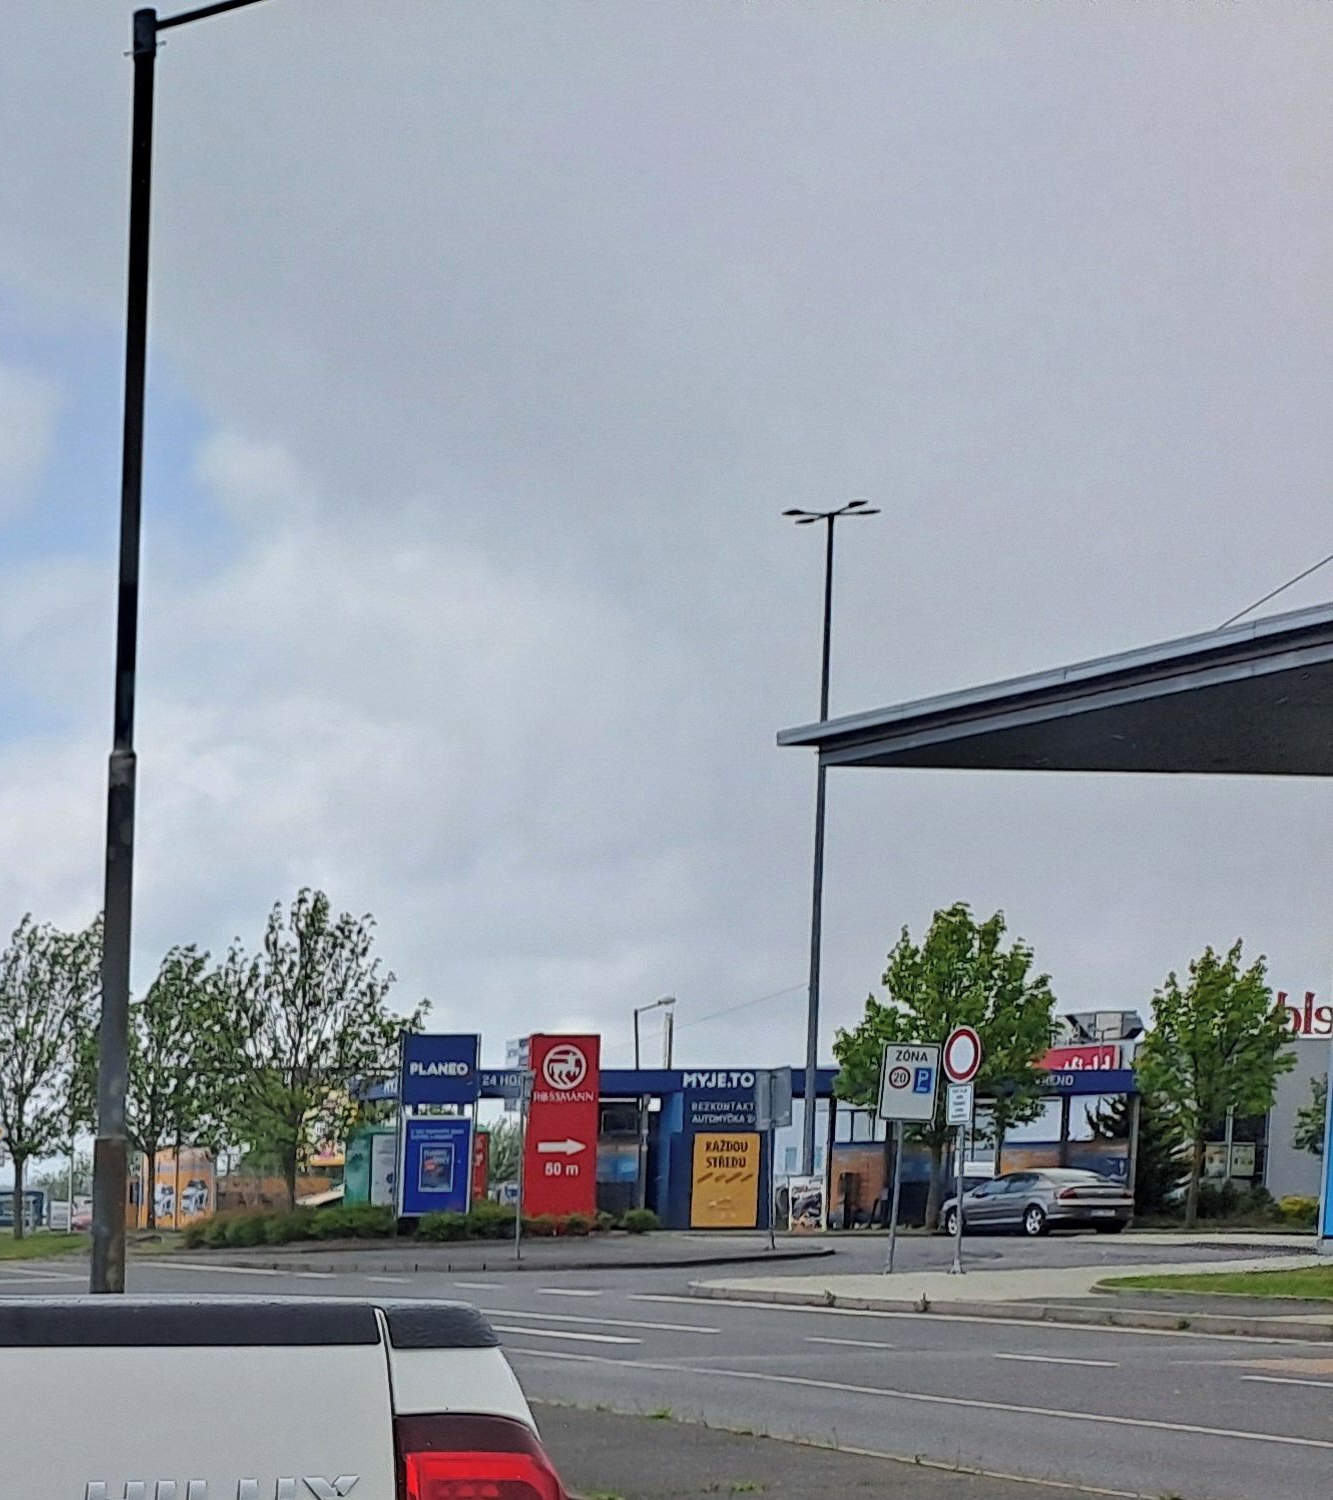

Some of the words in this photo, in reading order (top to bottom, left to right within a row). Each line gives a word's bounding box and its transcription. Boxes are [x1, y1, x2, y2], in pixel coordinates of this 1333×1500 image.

[895, 1049, 928, 1062] ZÓNA
[409, 1062, 469, 1076] PLANEO
[683, 1072, 754, 1088] MYJE.TO
[893, 1072, 907, 1083] 20
[566, 1165, 579, 1176] m
